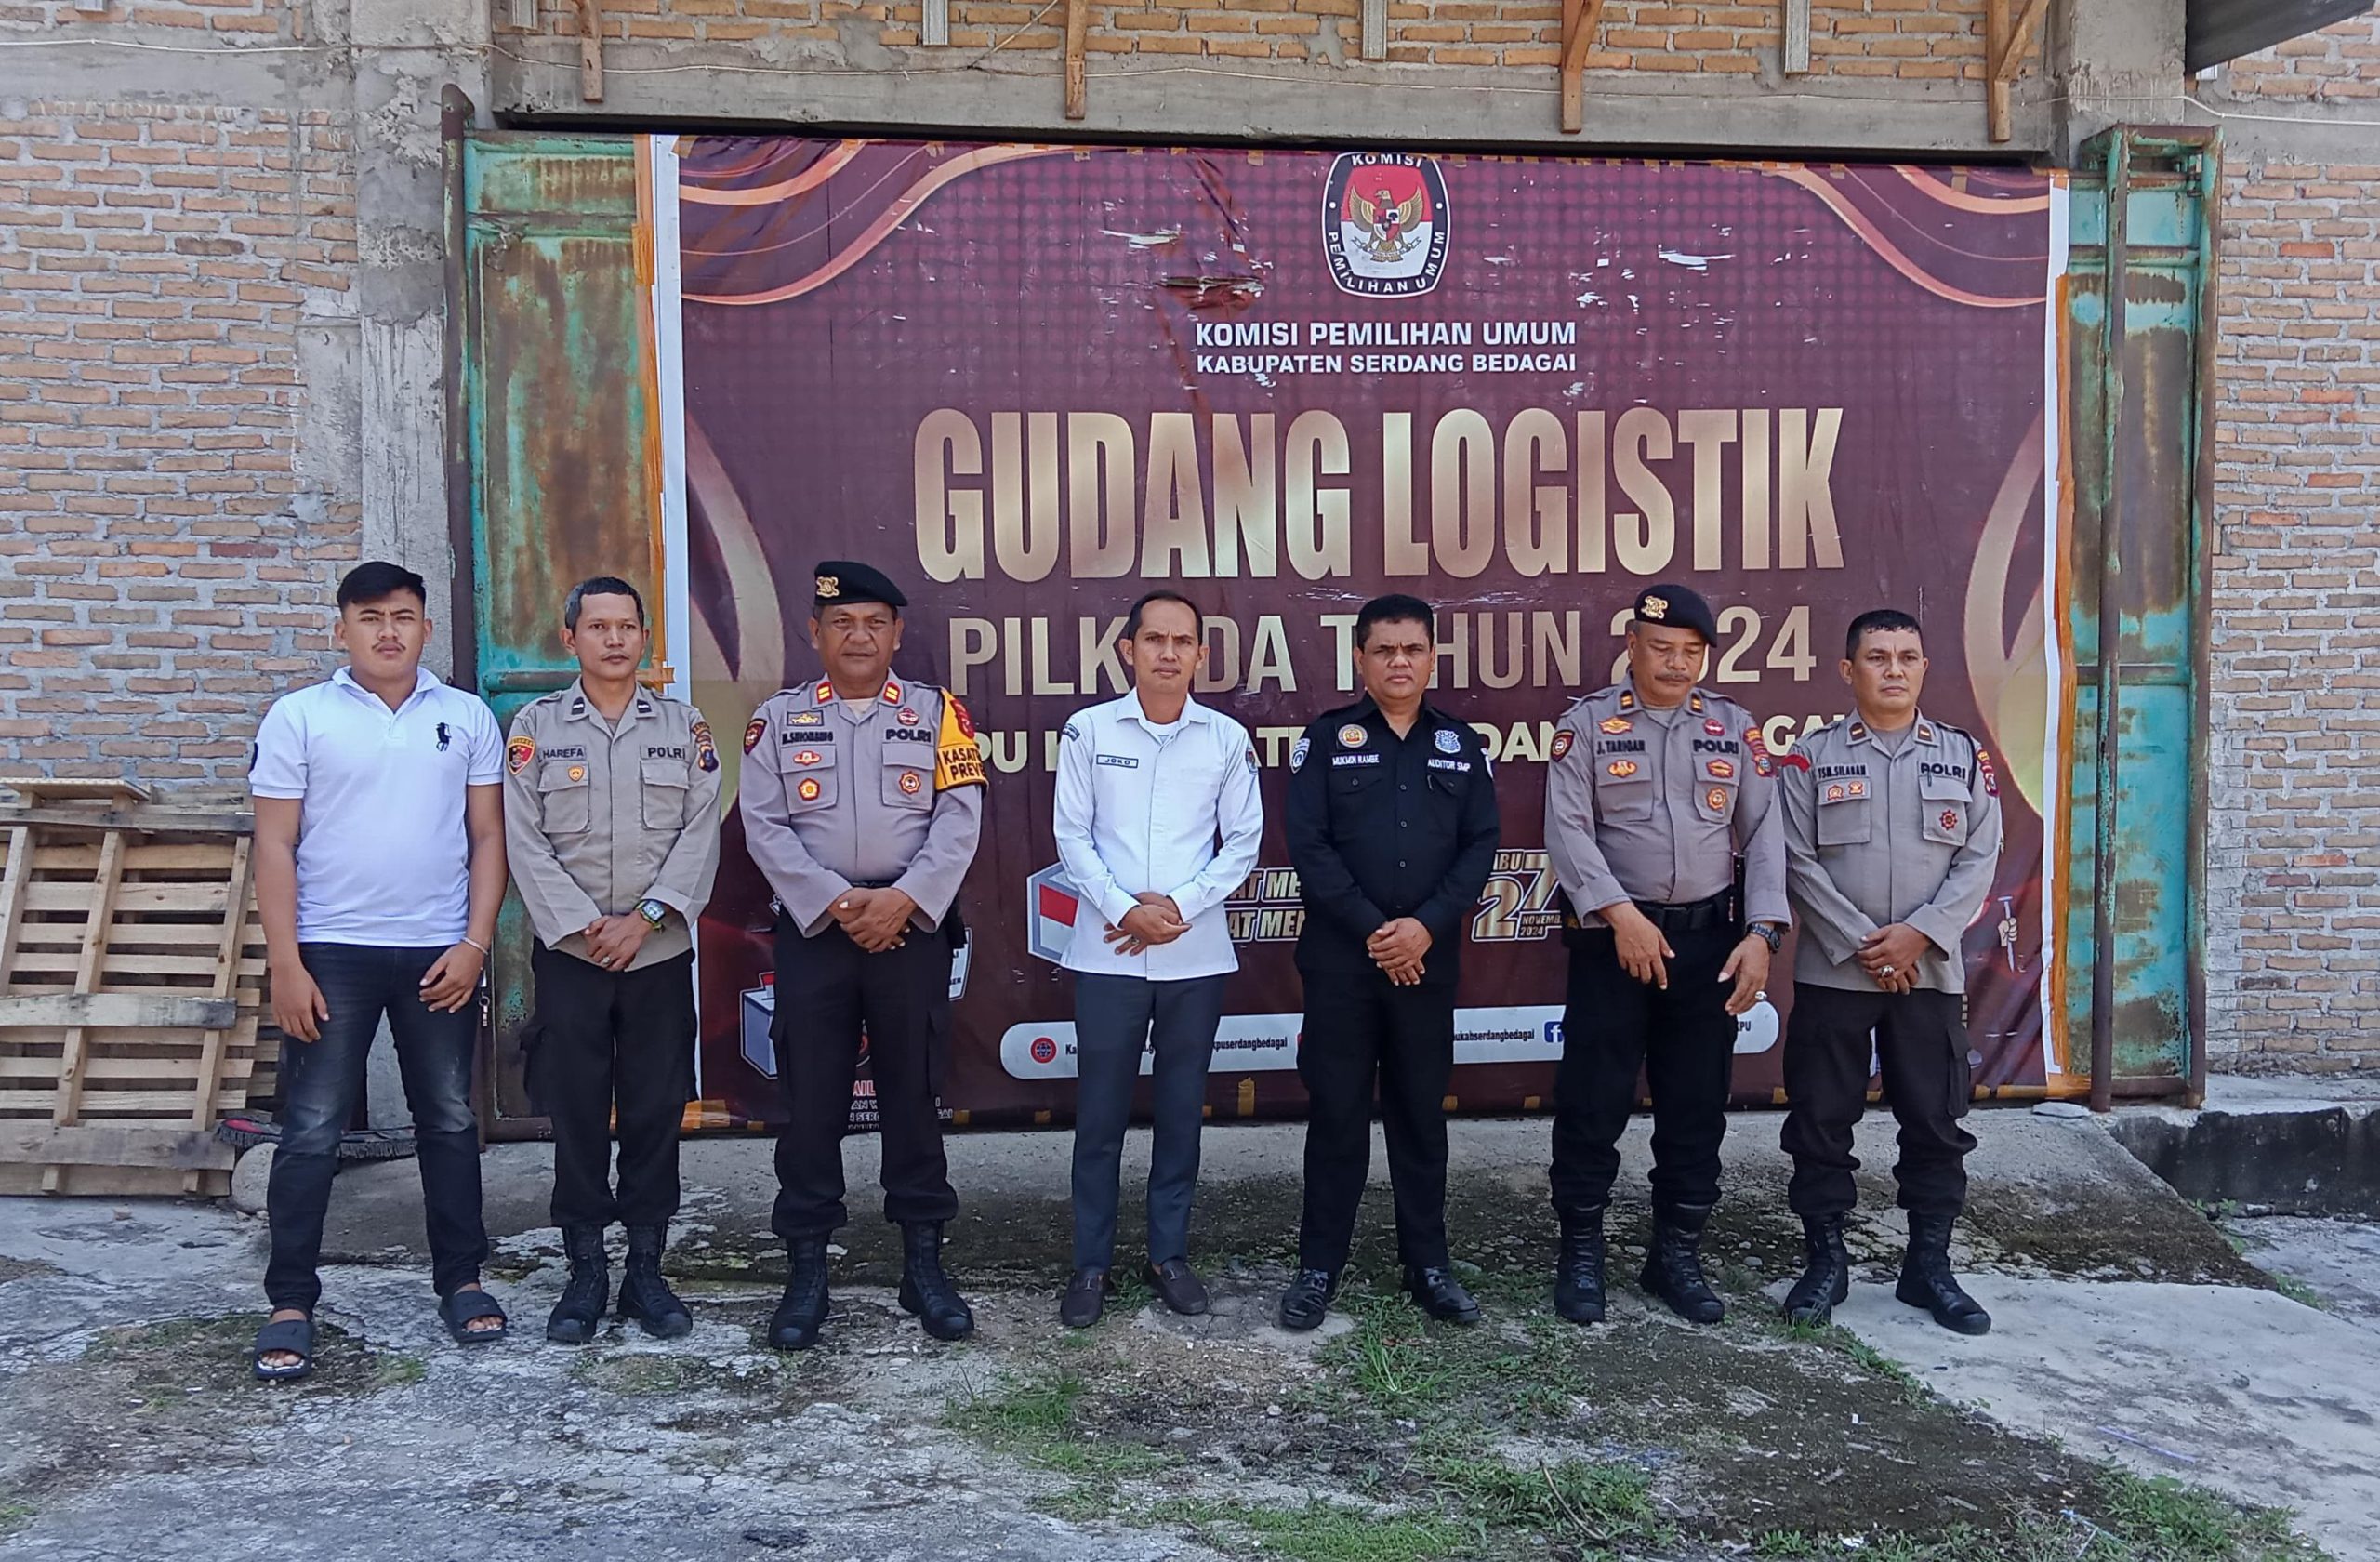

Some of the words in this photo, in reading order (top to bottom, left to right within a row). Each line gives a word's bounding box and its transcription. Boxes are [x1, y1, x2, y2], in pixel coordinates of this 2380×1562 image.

[1352, 154, 1421, 167] KOMISI
[1329, 232, 1408, 292] PEMILIHAN
[1416, 232, 1445, 288] UMUM
[1196, 323, 1298, 346] KOMISI
[1310, 322, 1472, 346] PEMILIHAN
[1483, 322, 1576, 345] UMUM
[1197, 355, 1342, 374] KABUPATEN
[1350, 354, 1463, 373] SERDANG
[1472, 354, 1576, 372] BEDAGAI
[914, 408, 1351, 583] GUDANG
[1383, 406, 1844, 579] LOGISTIK
[948, 616, 1297, 696] PILKDA
[1320, 610, 1580, 692] THUN
[1610, 605, 1817, 685] 224
[885, 729, 932, 743] POLRI
[543, 748, 584, 759] HAREFA
[648, 747, 686, 759] POLRI
[1694, 739, 1739, 754] POLRI
[1427, 759, 1455, 770] AUDITOR
[1921, 762, 1966, 779] POLRI
[1522, 914, 1562, 925] NOVEMB
[1521, 926, 1543, 936] 2024
